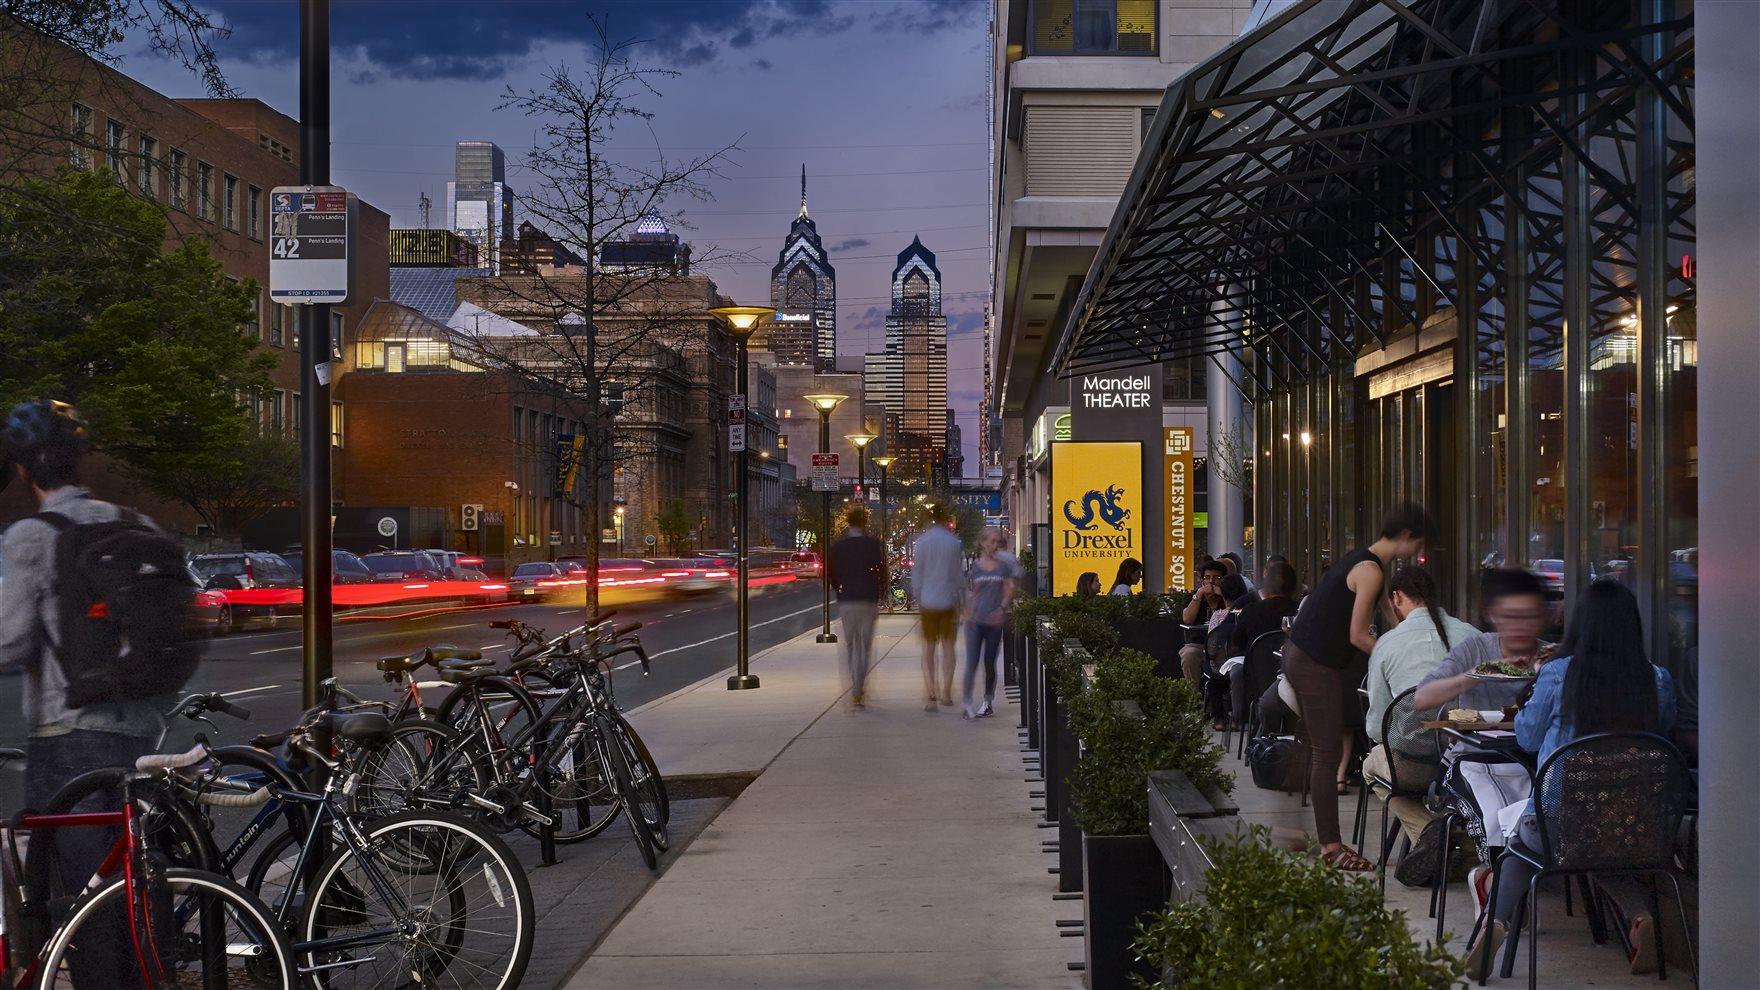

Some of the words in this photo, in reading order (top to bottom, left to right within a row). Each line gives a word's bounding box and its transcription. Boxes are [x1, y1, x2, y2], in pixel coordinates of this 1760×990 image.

[274, 238, 300, 258] 42
[782, 313, 810, 321] Beneficial
[1083, 375, 1150, 390] Mandell
[1083, 393, 1150, 408] THEATER
[1171, 461, 1185, 549] CHESTNUT
[1062, 527, 1134, 549] Drexel
[1064, 550, 1132, 558] UNIVERSITY
